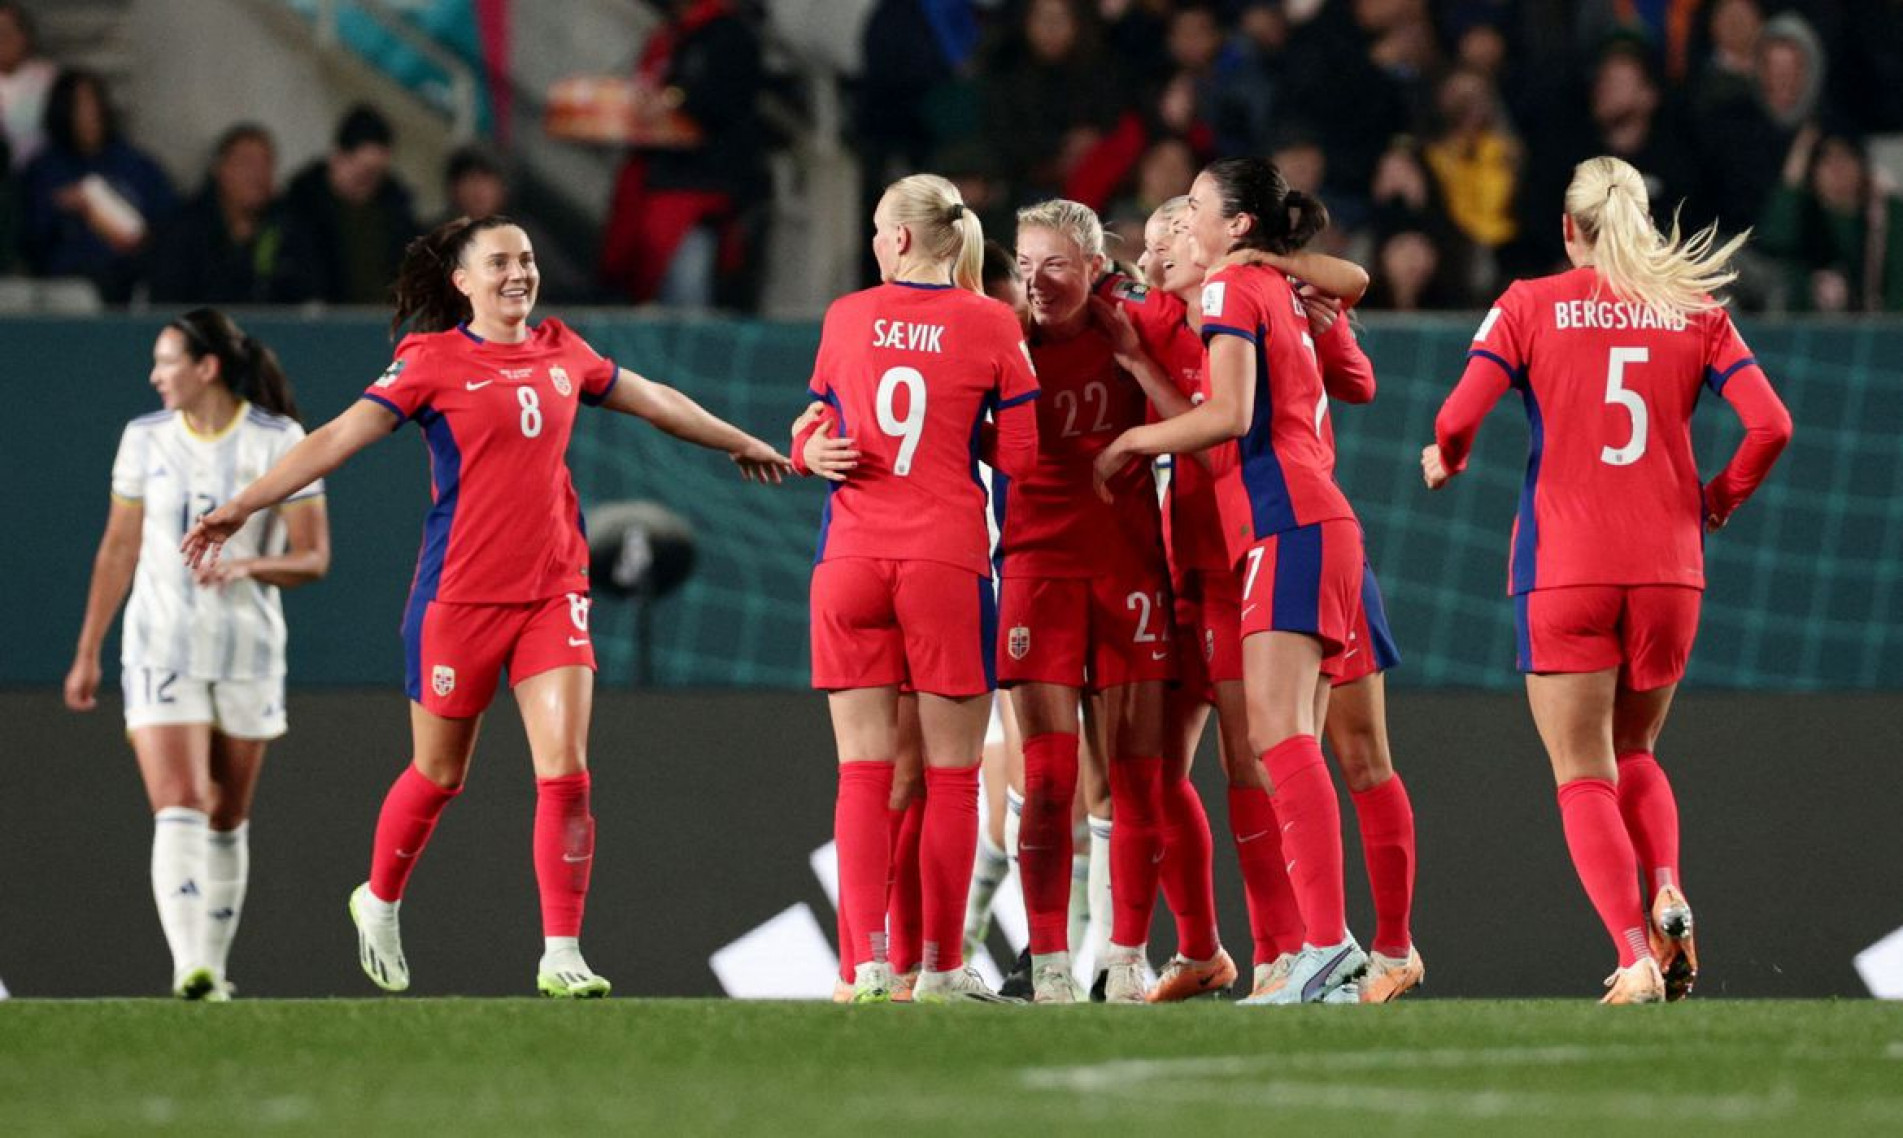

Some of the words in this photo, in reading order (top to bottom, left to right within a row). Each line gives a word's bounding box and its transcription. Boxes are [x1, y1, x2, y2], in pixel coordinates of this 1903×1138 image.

[873, 319, 944, 353] SÆVIK
[517, 386, 542, 438] 8
[876, 366, 927, 476] 9
[1054, 381, 1113, 438] 22
[1601, 347, 1649, 466] 5
[1244, 546, 1265, 600] 7
[566, 592, 590, 631] 8
[1126, 591, 1168, 642] 2
[142, 667, 178, 704] 12
